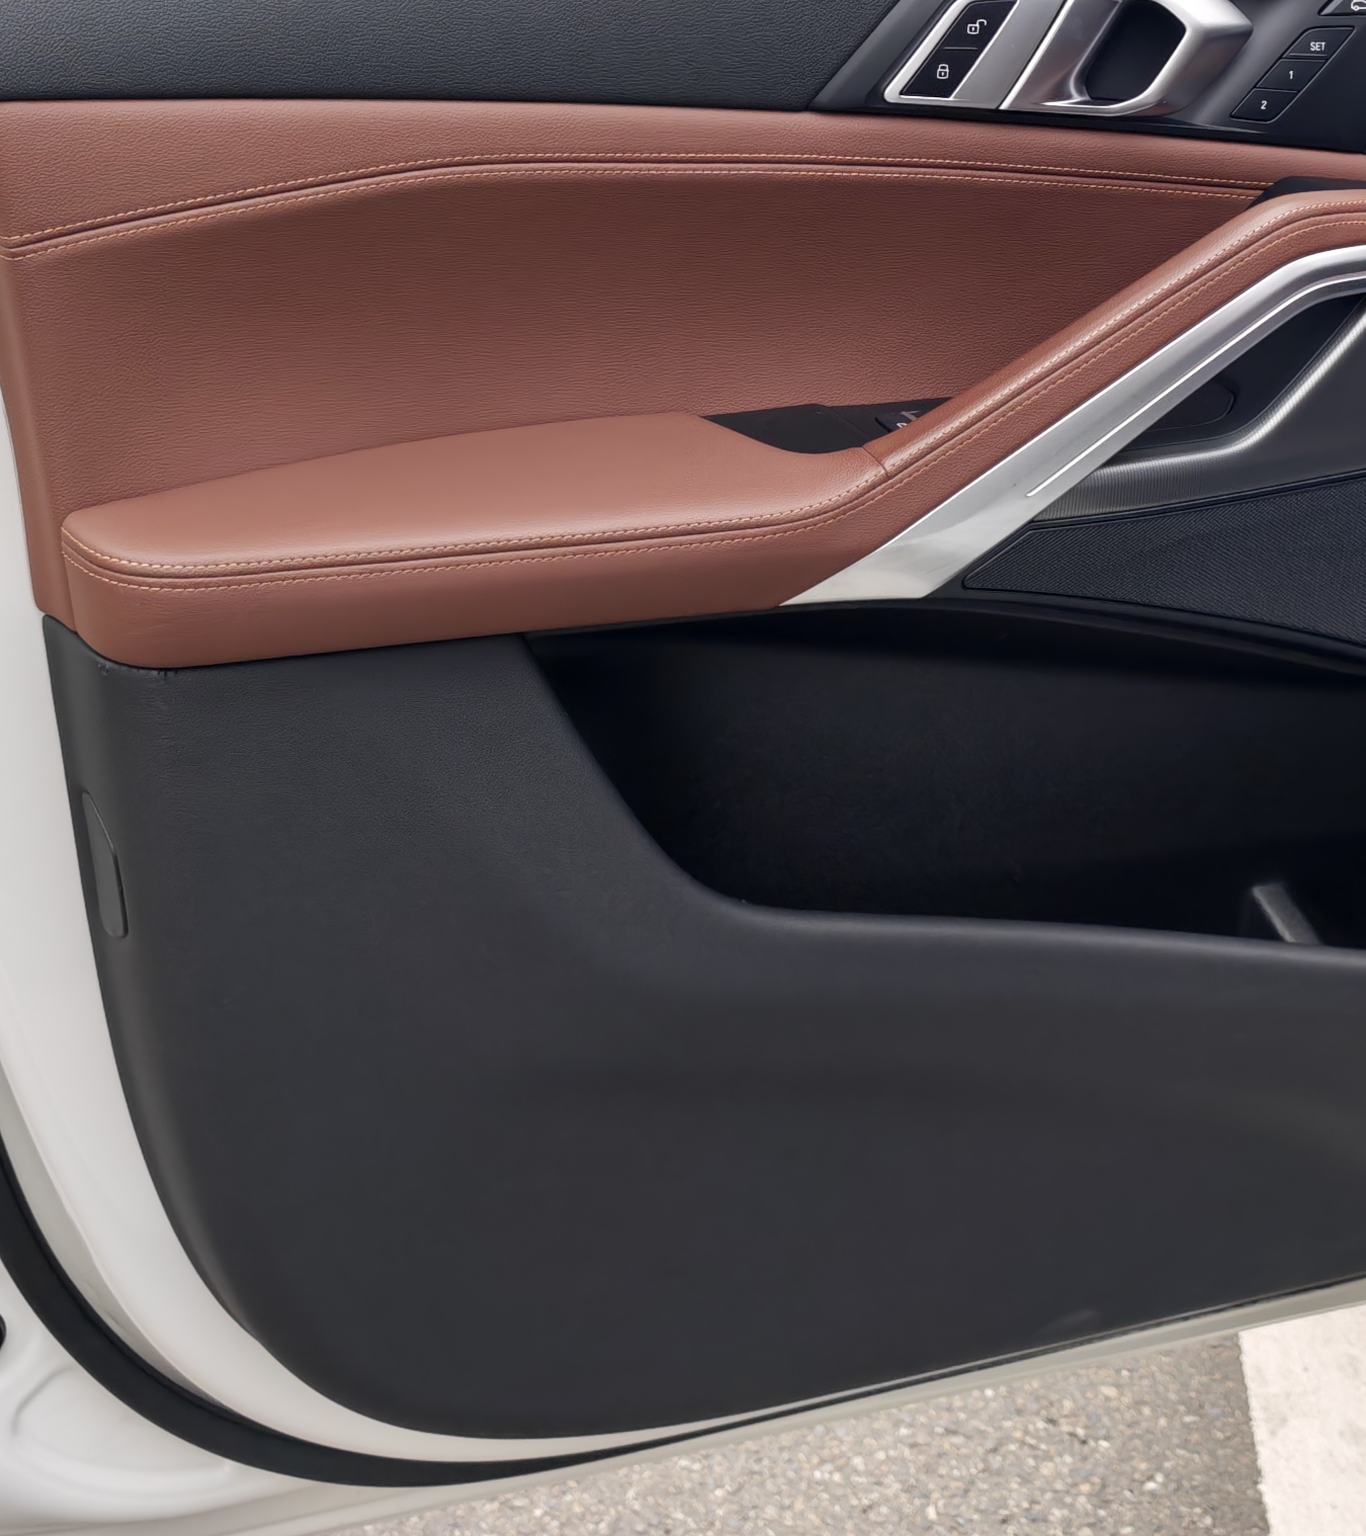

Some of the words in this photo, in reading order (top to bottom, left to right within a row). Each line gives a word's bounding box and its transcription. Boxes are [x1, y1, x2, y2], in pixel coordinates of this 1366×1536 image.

[1310, 41, 1327, 52] SET
[1288, 70, 1294, 80] 1
[1260, 100, 1267, 110] 2
